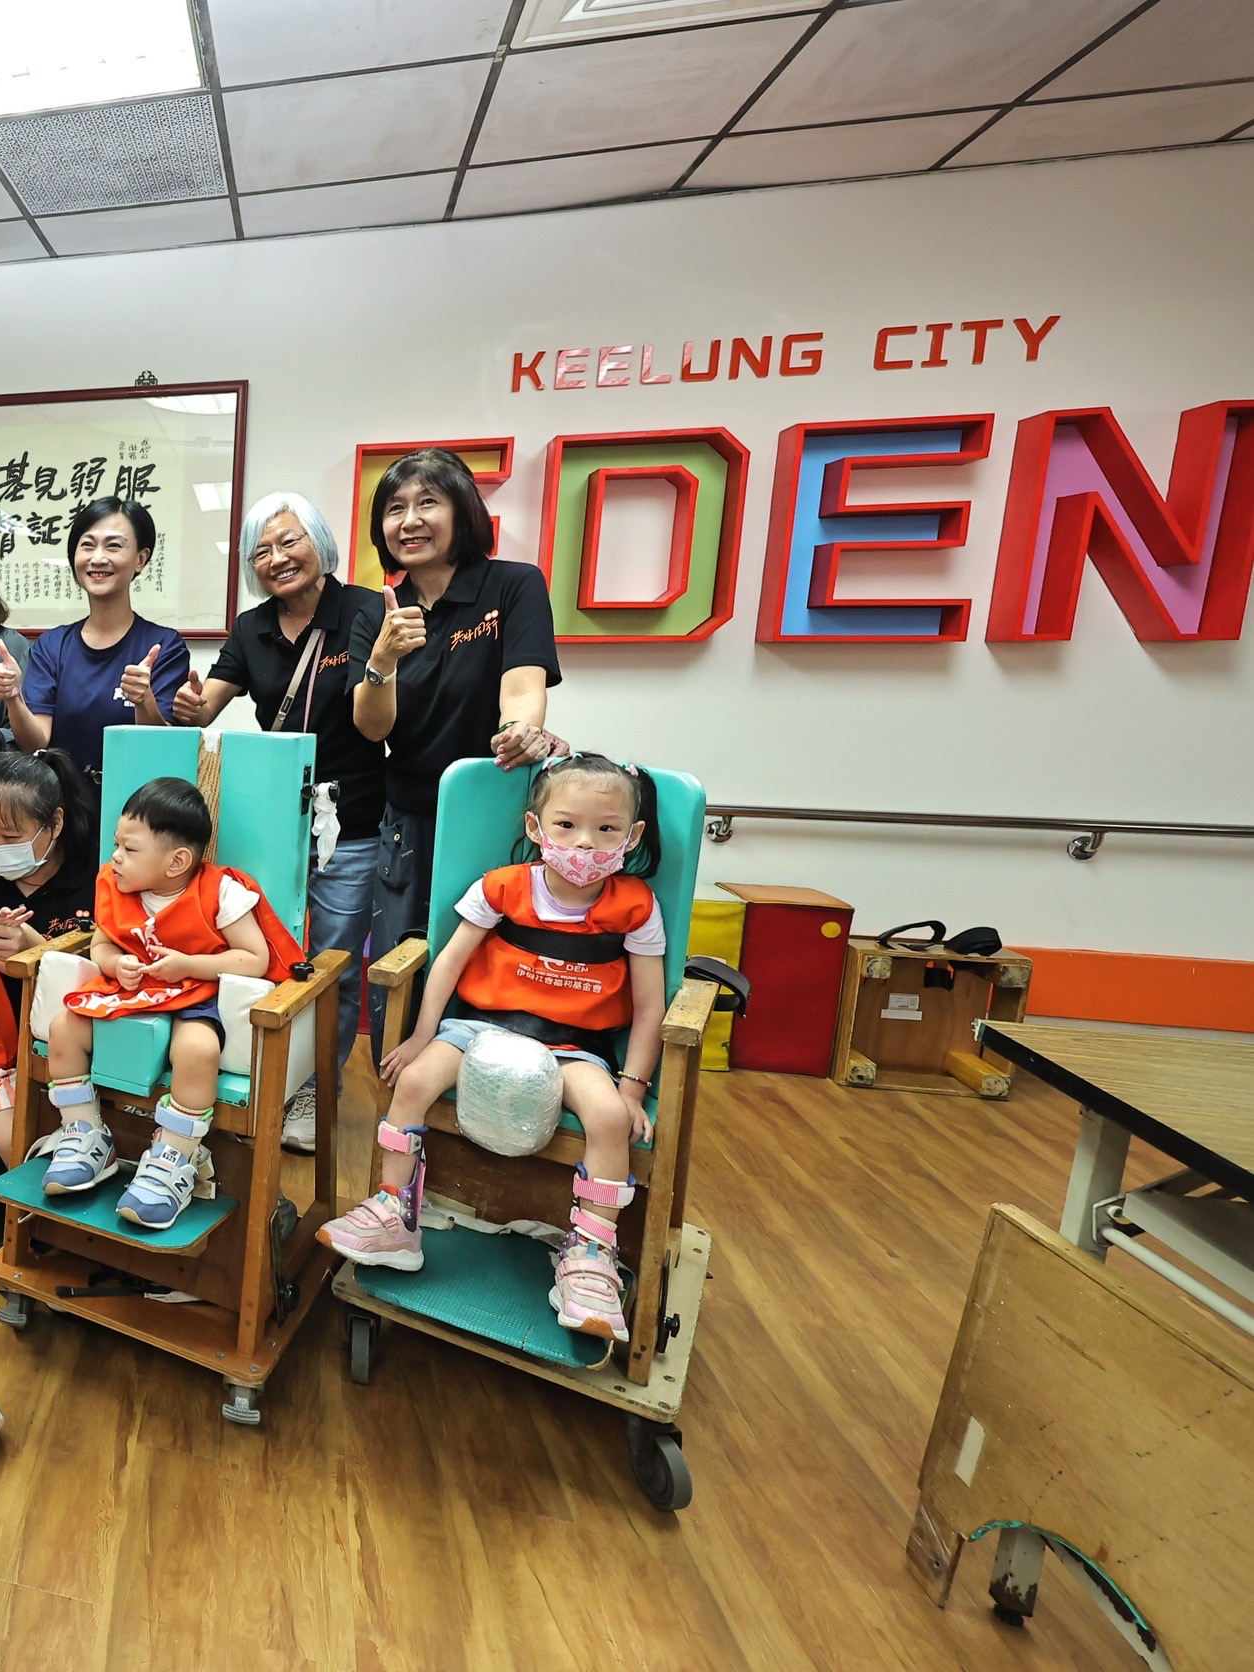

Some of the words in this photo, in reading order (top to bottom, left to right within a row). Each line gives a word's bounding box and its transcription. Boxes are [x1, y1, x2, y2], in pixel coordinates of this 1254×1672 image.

[511, 331, 823, 393] KEELUNG
[874, 315, 1061, 371] CITY
[515, 968, 603, 994] 伊甸社會福利基金會
[90, 1147, 104, 1162] N
[174, 1177, 189, 1194] N
